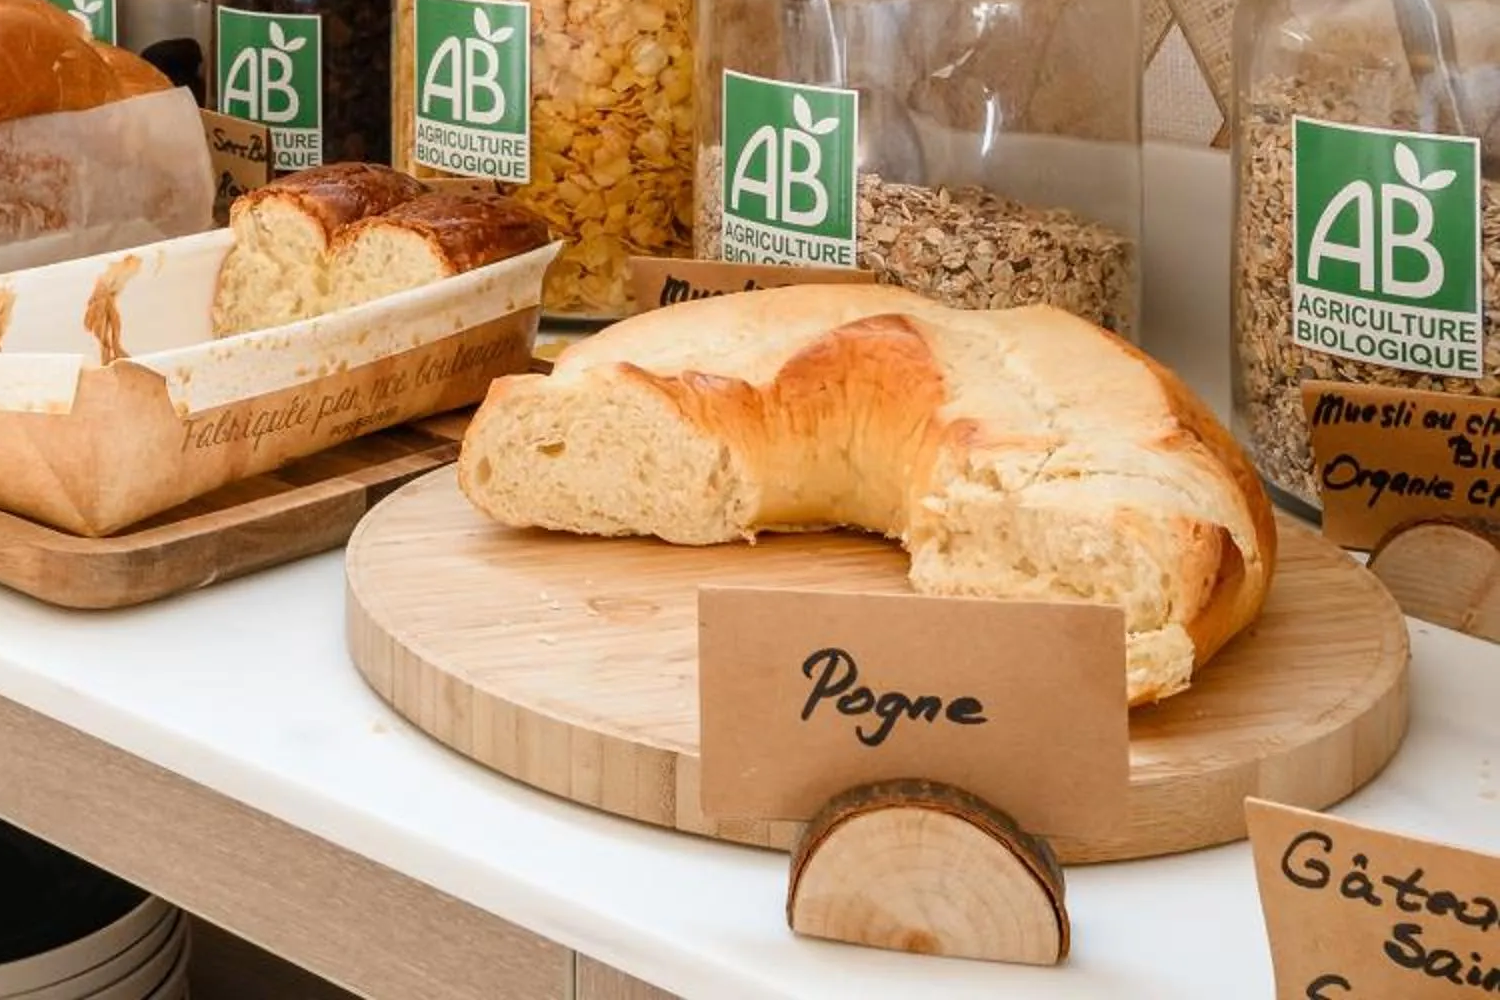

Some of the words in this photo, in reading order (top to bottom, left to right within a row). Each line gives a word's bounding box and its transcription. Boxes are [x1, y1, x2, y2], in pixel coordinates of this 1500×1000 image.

[223, 47, 300, 123] AB
[422, 36, 505, 125] AB
[417, 123, 526, 157] AGRICULTURE
[417, 144, 526, 179] BIOLOGIQUE
[732, 125, 829, 226] AB
[725, 221, 851, 265] AGRICULTURE
[1307, 180, 1445, 299] AB
[1297, 319, 1478, 371] BIOLOGIQUE
[1298, 293, 1477, 344] AGRICULTURE
[1312, 392, 1417, 428] Muesli
[1322, 454, 1454, 508] Organic
[802, 647, 988, 747] Pogne
